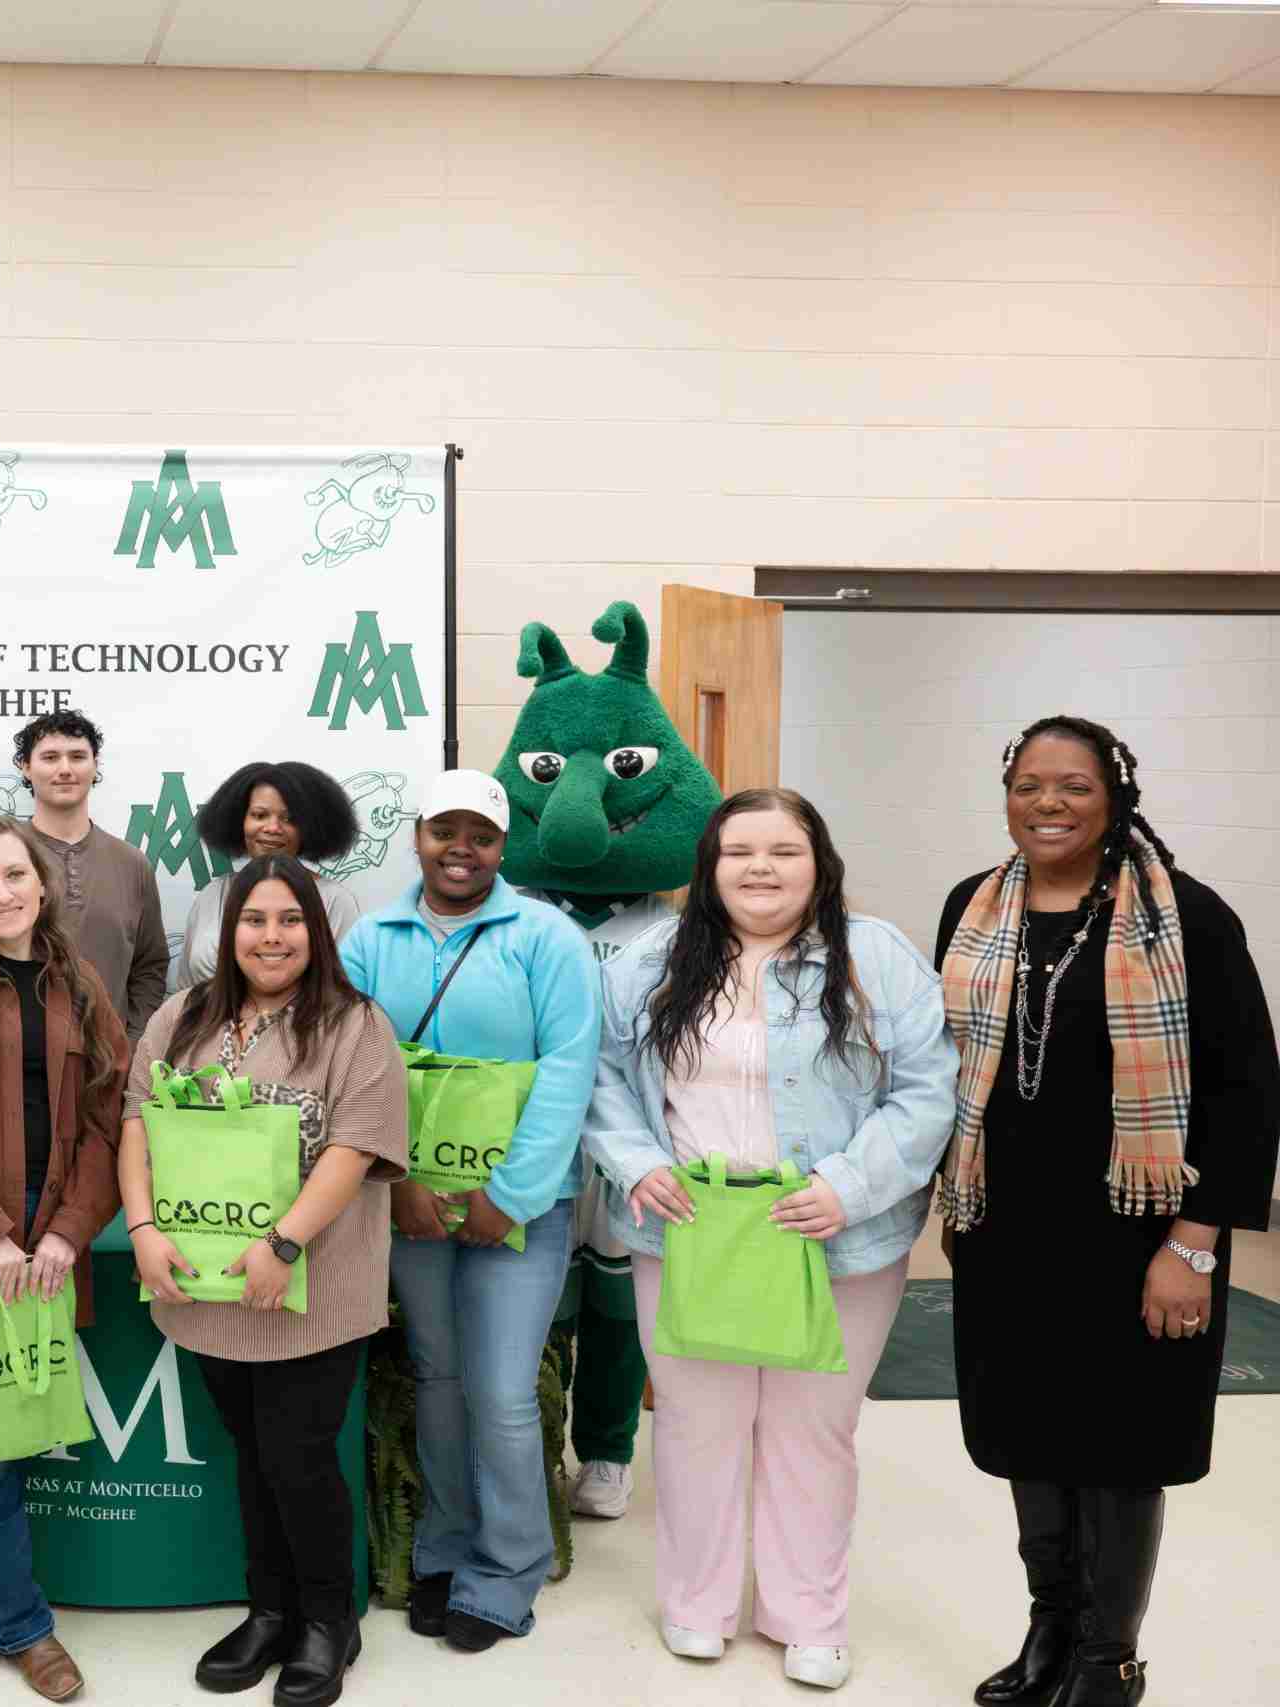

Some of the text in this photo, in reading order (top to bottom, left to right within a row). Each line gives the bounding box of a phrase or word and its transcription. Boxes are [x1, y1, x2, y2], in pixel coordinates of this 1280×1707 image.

[20, 643, 289, 675] TECHNOLOGY
[64, 1480, 85, 1495] AT
[89, 1480, 204, 1498] MONTICELLO
